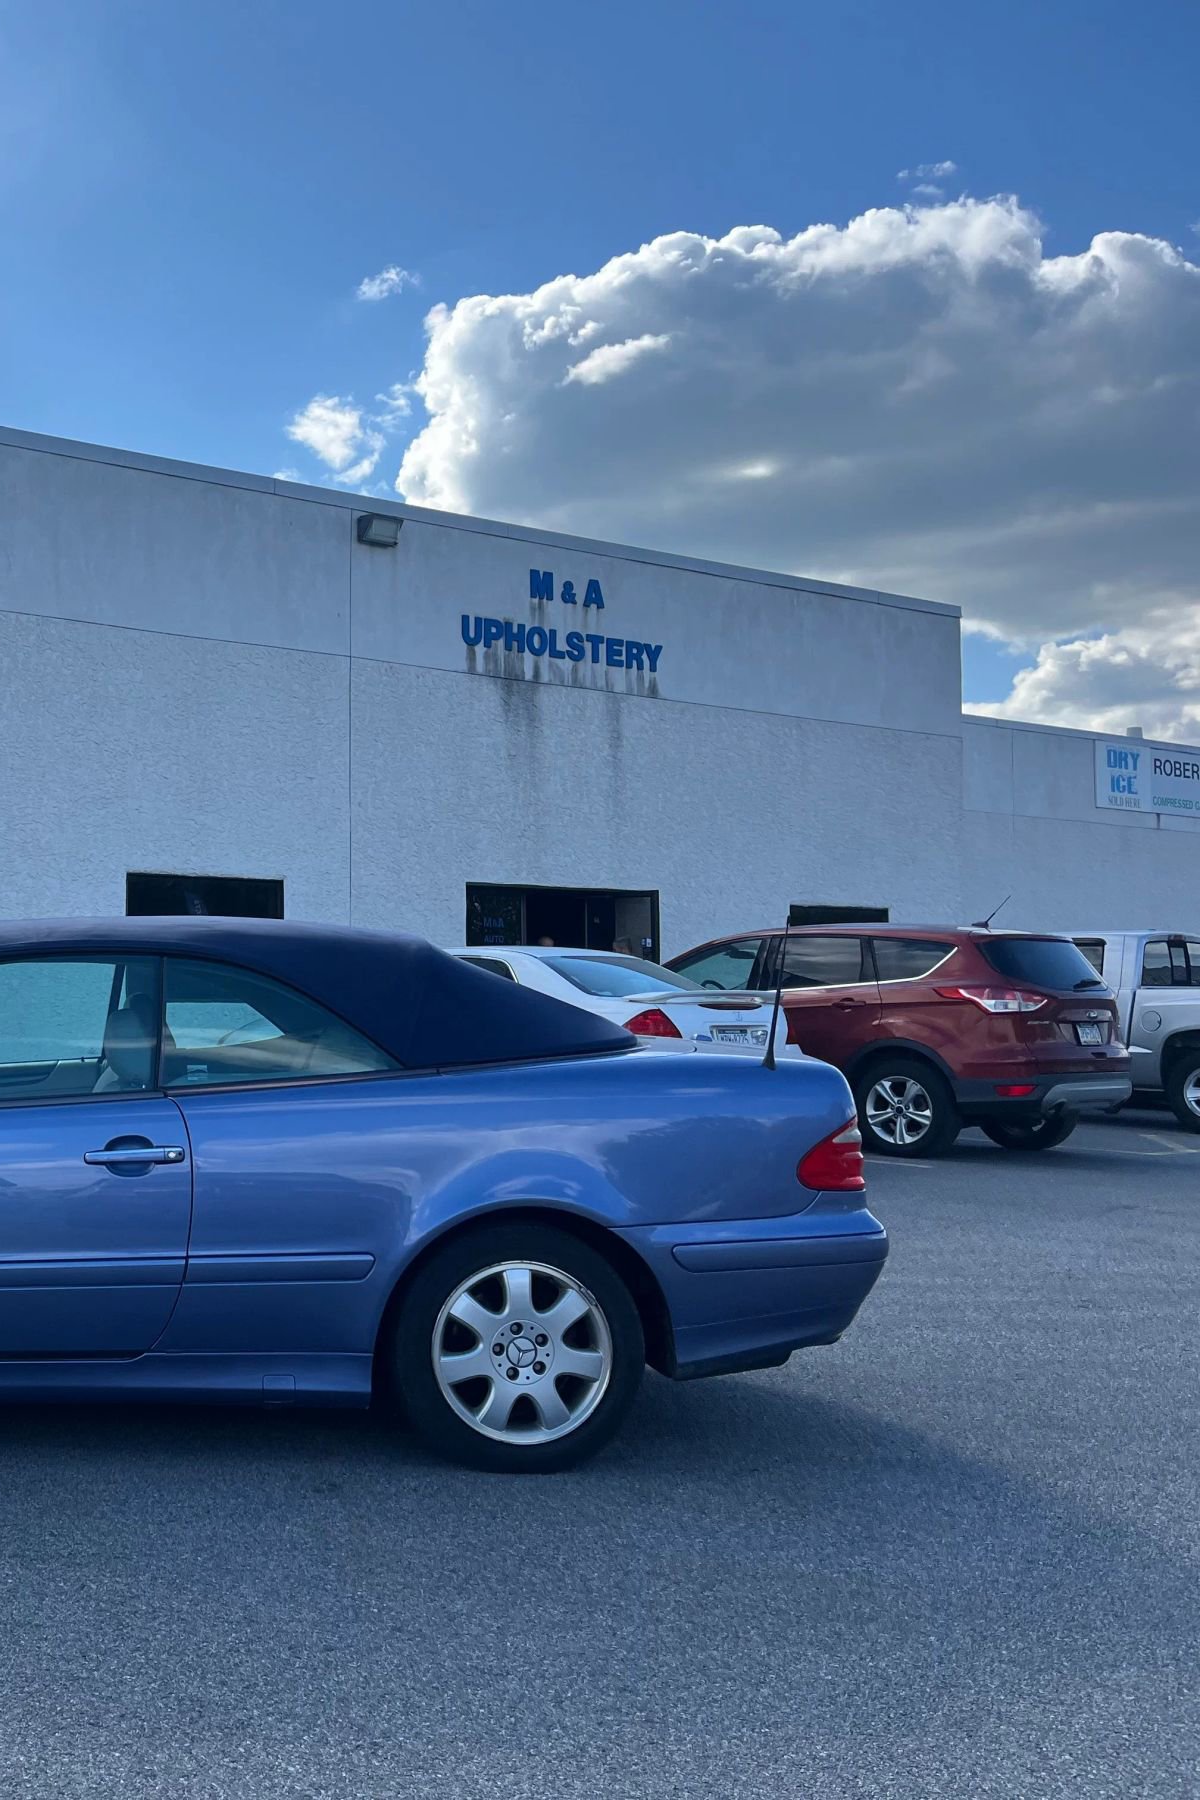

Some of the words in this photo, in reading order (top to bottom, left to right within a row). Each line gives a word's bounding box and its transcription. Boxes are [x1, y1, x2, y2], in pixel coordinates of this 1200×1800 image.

[529, 568, 554, 601] M
[561, 580, 577, 604] &
[582, 579, 605, 609] A
[461, 615, 663, 673] UPHOLSTERY
[1107, 749, 1140, 771] DRY
[1110, 774, 1138, 794] ICE
